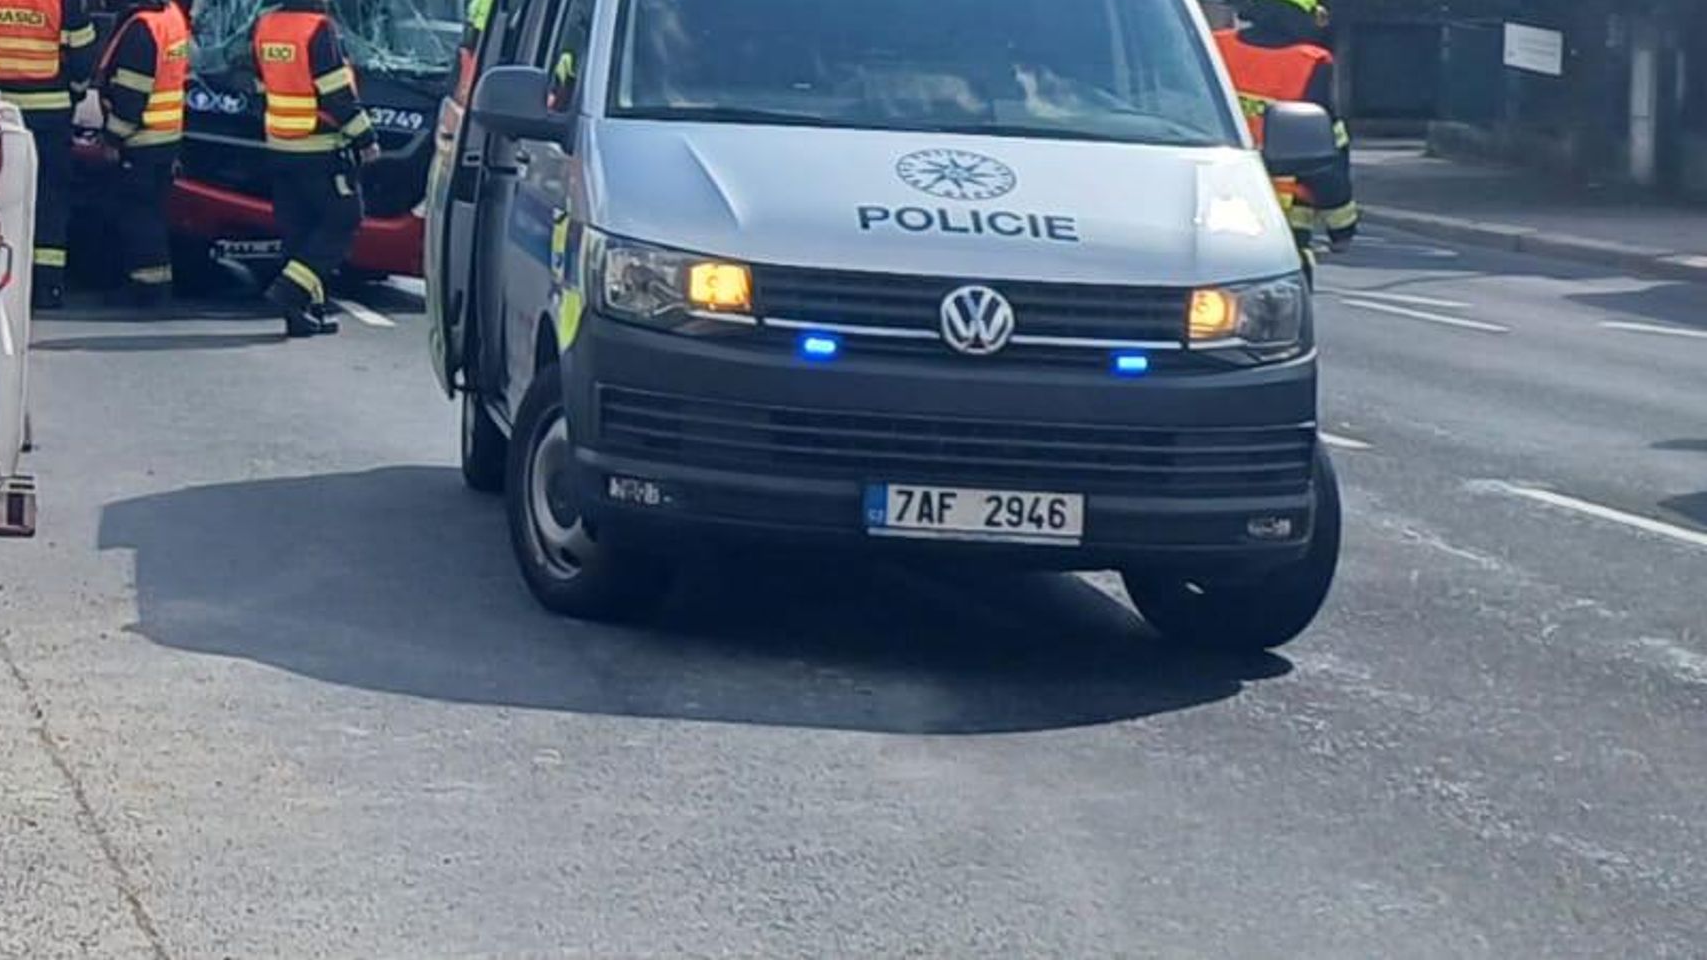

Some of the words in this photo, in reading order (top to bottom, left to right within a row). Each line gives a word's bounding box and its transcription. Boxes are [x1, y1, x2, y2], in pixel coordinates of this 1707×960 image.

[370, 106, 423, 130] 3749
[857, 205, 1080, 242] POLICIE
[895, 490, 957, 524] 7AF
[984, 495, 1067, 530] 2946
